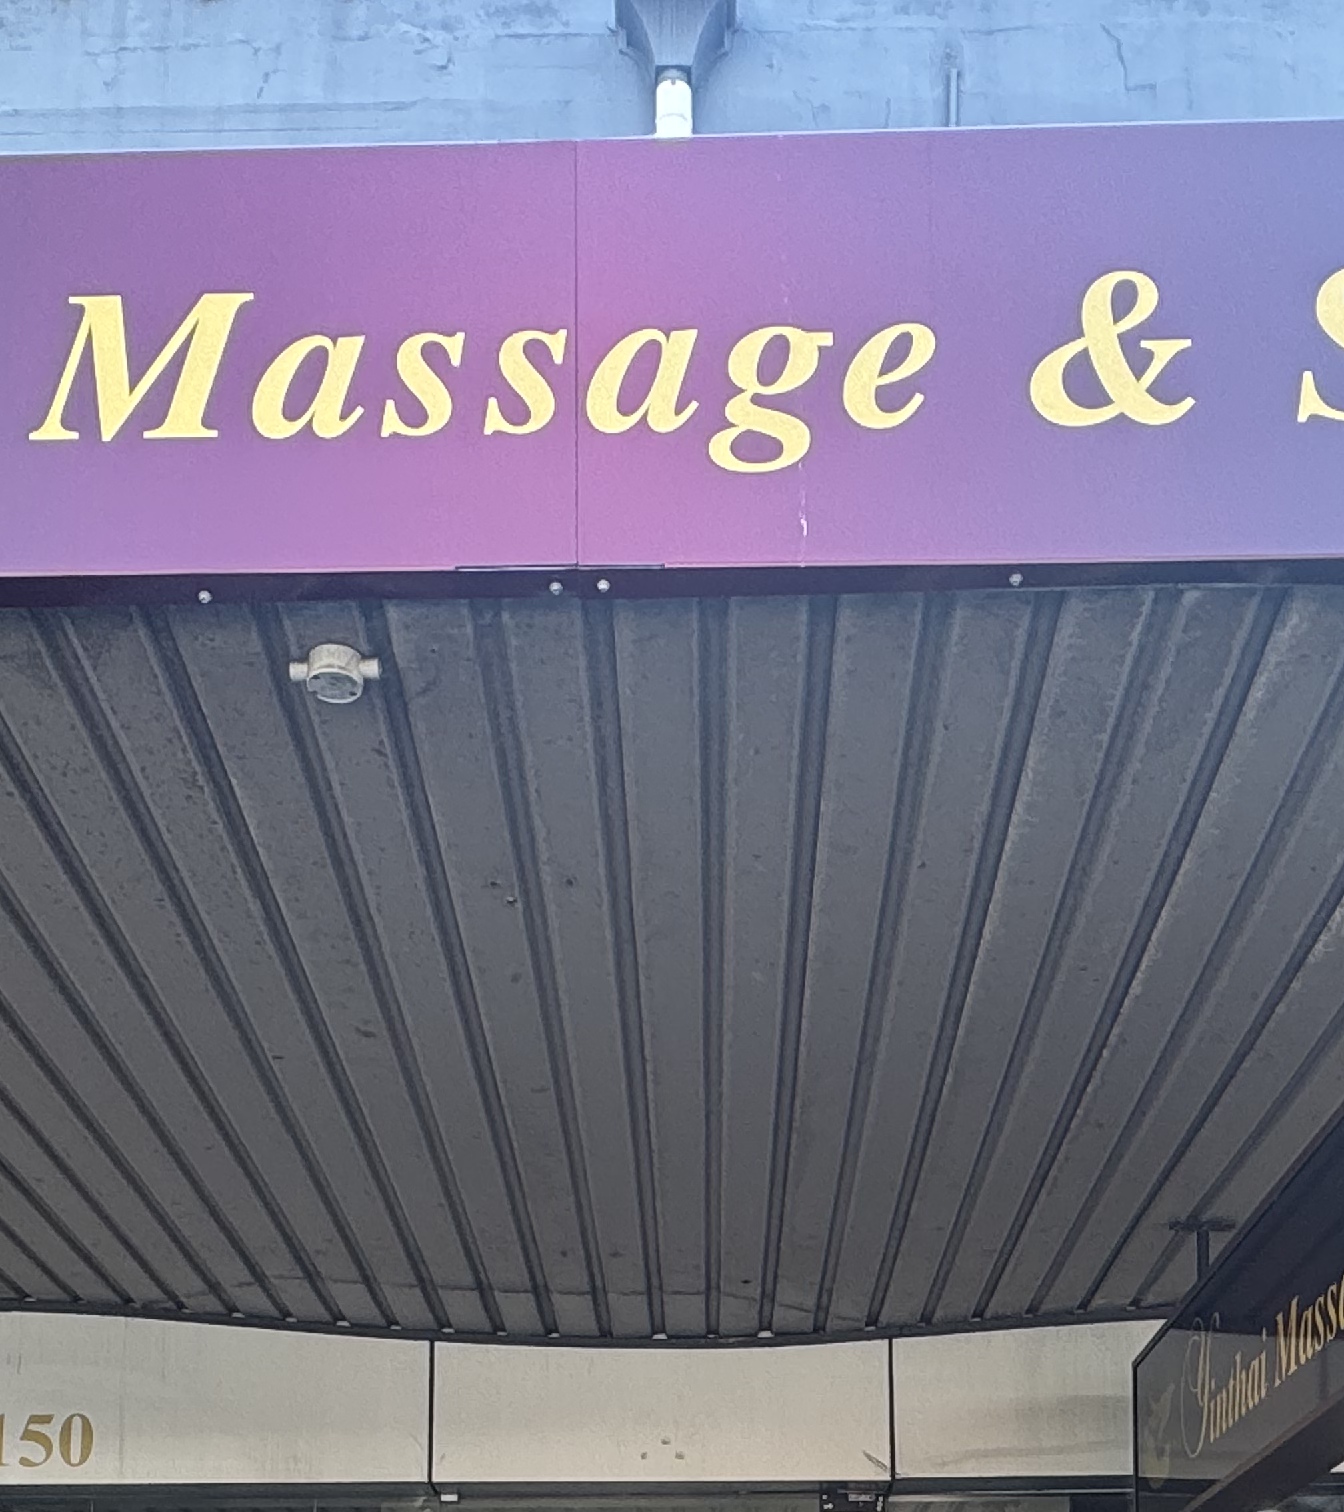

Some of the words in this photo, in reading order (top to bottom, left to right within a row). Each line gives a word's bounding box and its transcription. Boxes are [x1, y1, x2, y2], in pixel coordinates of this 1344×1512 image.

[28, 292, 937, 474] Massage
[1029, 270, 1197, 428] &
[1181, 1313, 1269, 1458] Yinthai
